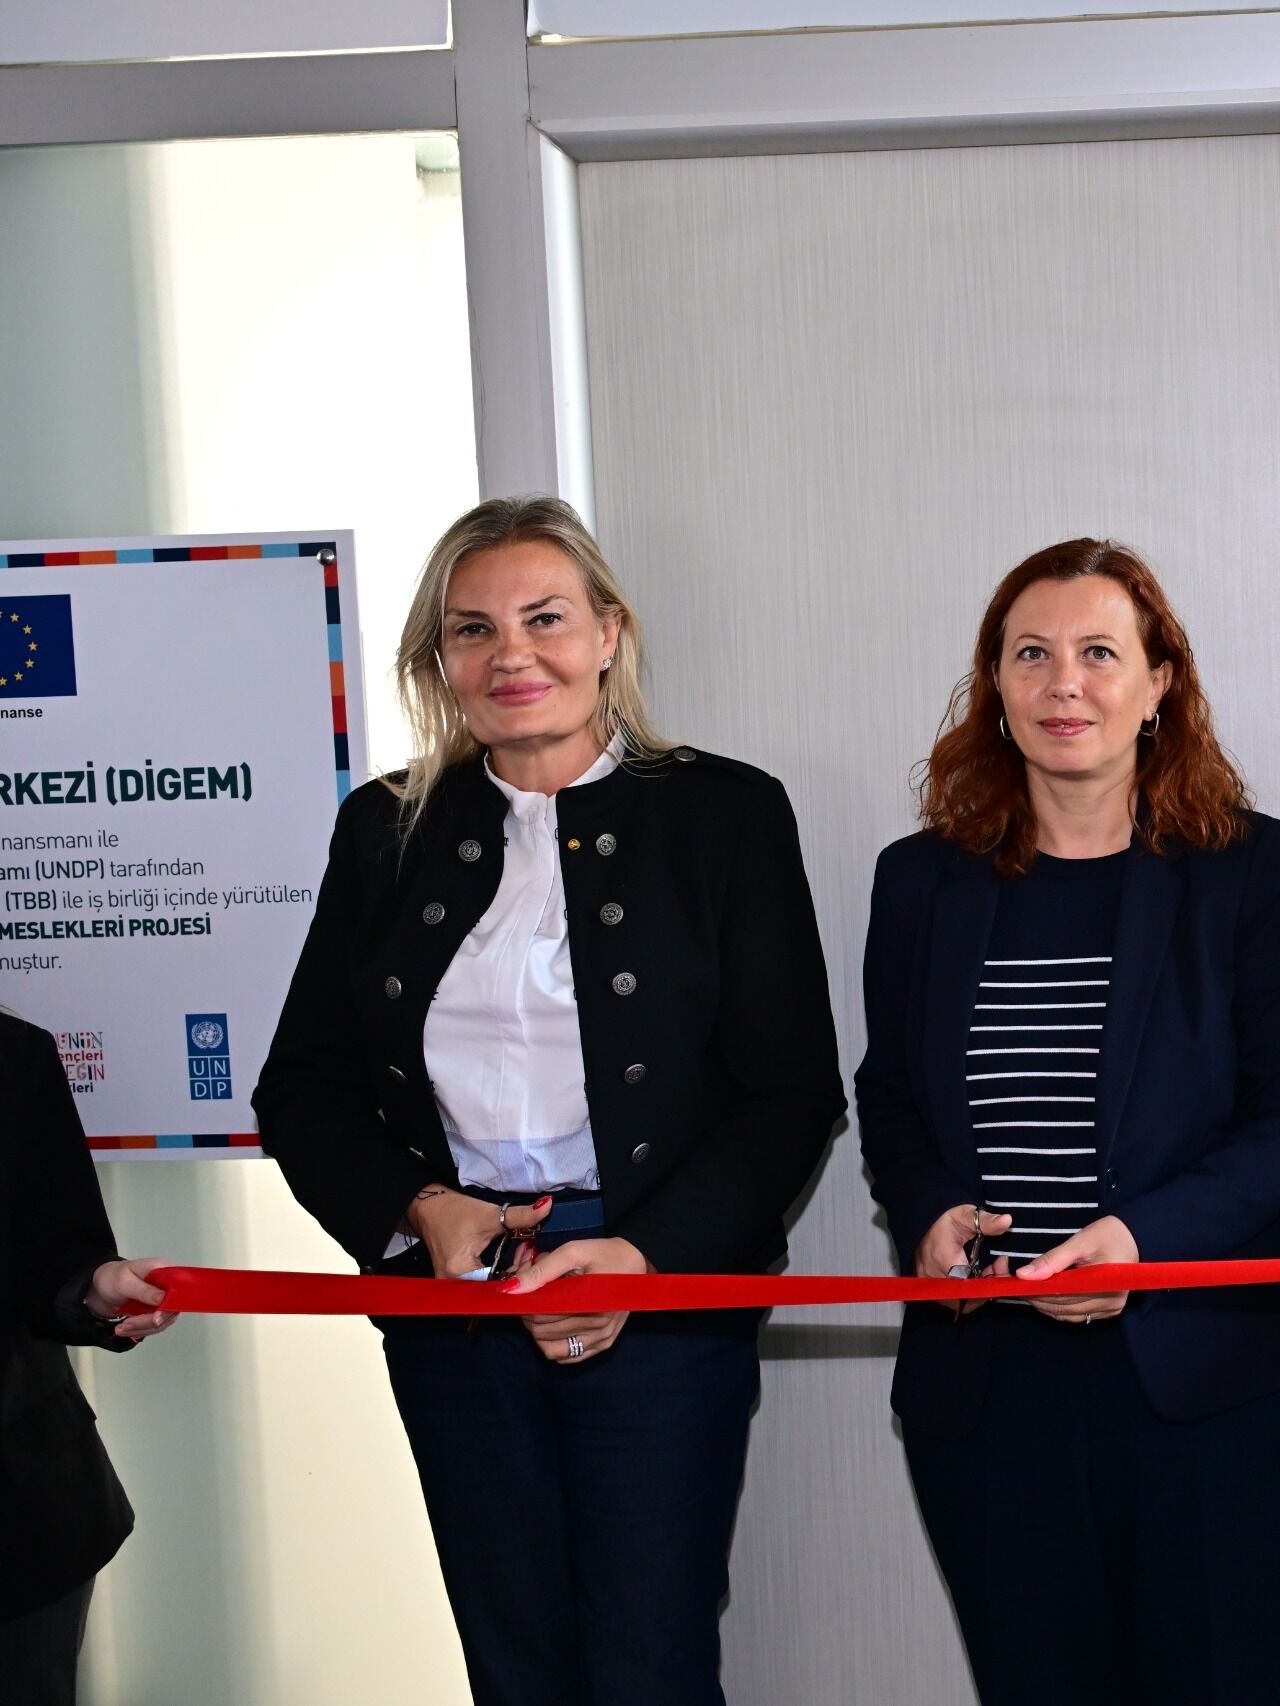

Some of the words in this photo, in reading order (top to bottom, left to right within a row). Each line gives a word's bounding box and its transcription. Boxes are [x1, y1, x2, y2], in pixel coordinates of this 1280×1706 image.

[0, 708, 43, 718] nanse
[106, 758, 252, 806] (DİGEM)
[98, 829, 119, 848] ile
[35, 858, 105, 881] (UNDP)
[110, 857, 204, 878] tarafından
[5, 889, 57, 912] (TBB)
[62, 890, 83, 909] ile
[88, 889, 104, 913] iş
[108, 888, 159, 912] birliği
[164, 887, 218, 911] içinde
[222, 884, 312, 910] yürütülen
[0, 914, 125, 940] MESLEKLERİ
[128, 912, 212, 937] PROJESİ
